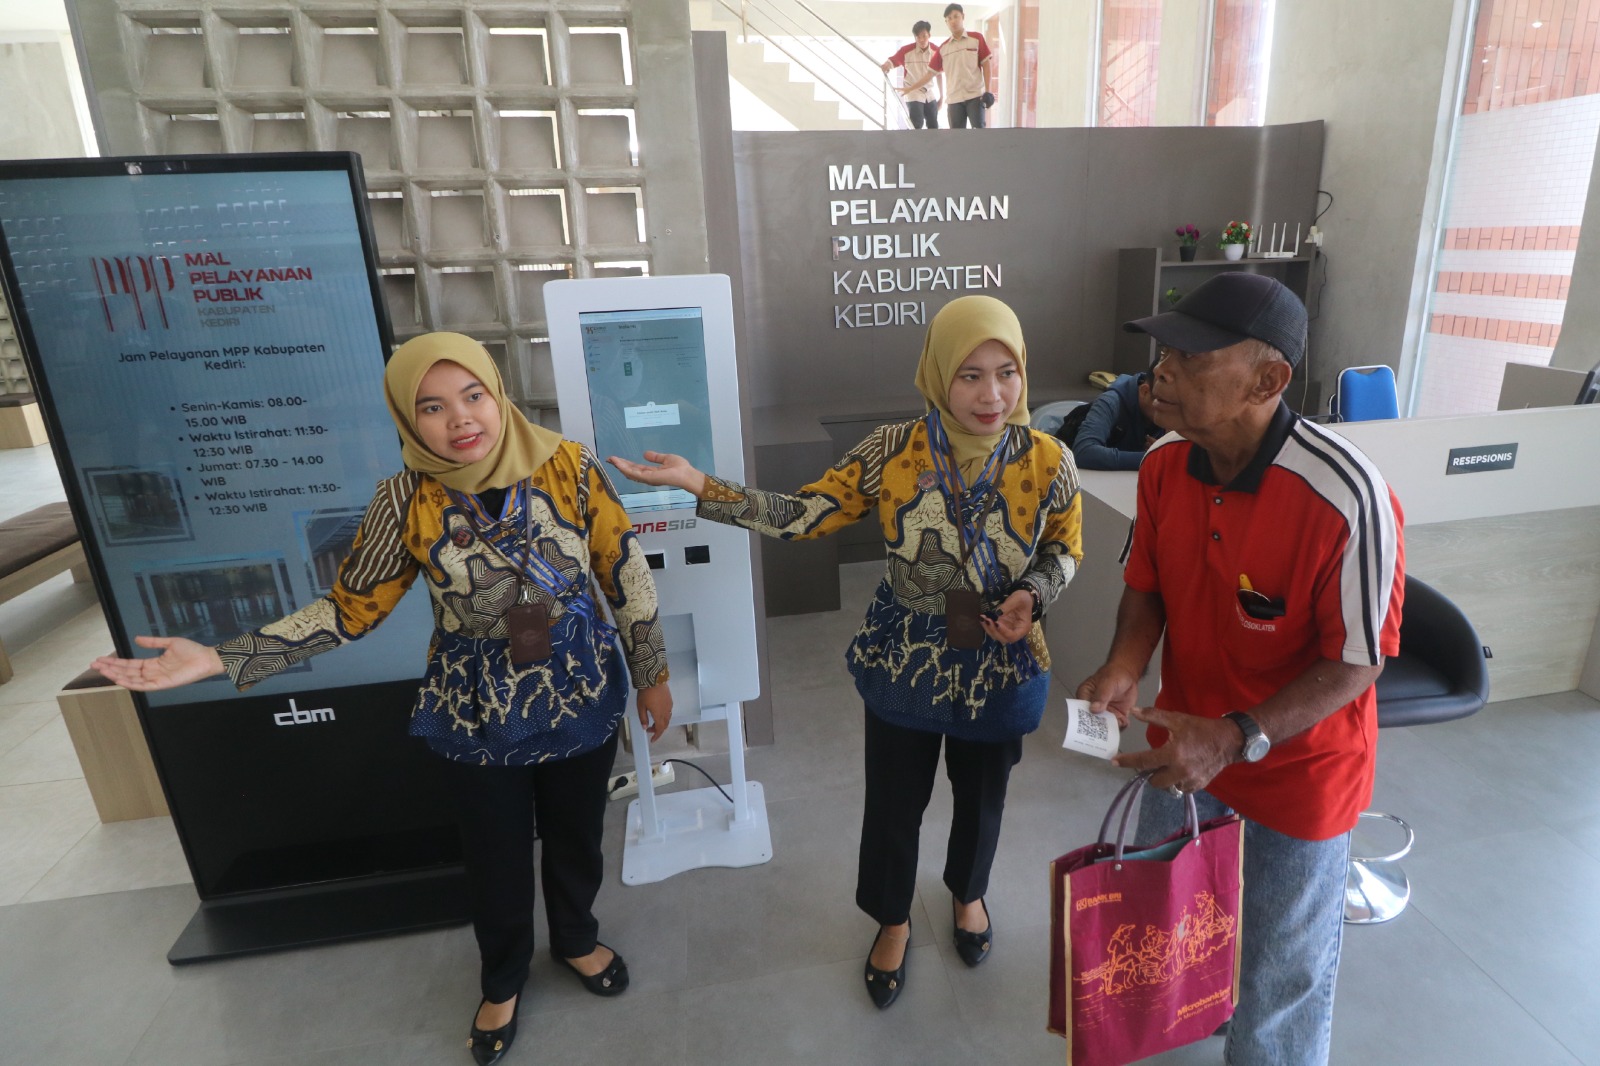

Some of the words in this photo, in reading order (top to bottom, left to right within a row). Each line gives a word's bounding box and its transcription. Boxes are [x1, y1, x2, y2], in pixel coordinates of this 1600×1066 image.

[828, 163, 916, 191] MALL
[830, 195, 1009, 225] PELAYANAN
[832, 232, 941, 261] PUBLIK
[184, 252, 231, 267] MAL
[189, 267, 313, 285] PELAYANAN
[833, 264, 1002, 295] KABUPATEN
[193, 287, 264, 303] PUBLIK
[198, 304, 276, 317] KABUPATEN
[834, 301, 926, 329] KEDIRI
[201, 318, 241, 328] KEDIRI
[118, 352, 146, 363] Jam
[149, 349, 220, 363] Pelayanan
[222, 346, 250, 357] MPP
[253, 344, 326, 357] Kabupaten
[204, 359, 246, 371] Kediri:
[181, 399, 265, 413] Senin-Kamis:
[267, 396, 308, 408] 08.00-
[185, 416, 218, 428] 15.00
[220, 415, 247, 426] WIB
[189, 430, 231, 443] Waktu
[234, 428, 292, 440] Istirahat:
[294, 425, 329, 436] 11:30-
[193, 446, 225, 458] 12:30
[228, 444, 254, 456] WIB
[1452, 452, 1513, 466] RESEPSIONIS
[198, 461, 242, 473] Jumat:
[245, 457, 279, 469] 07.30
[291, 454, 324, 467] 14.00
[201, 476, 227, 487] WIB
[204, 490, 246, 502] Waktu
[249, 486, 306, 499] Istirahat:
[308, 483, 342, 495] 11:30-
[208, 504, 240, 516] 12:30
[242, 502, 268, 513] WIB
[273, 698, 336, 726] cbm
